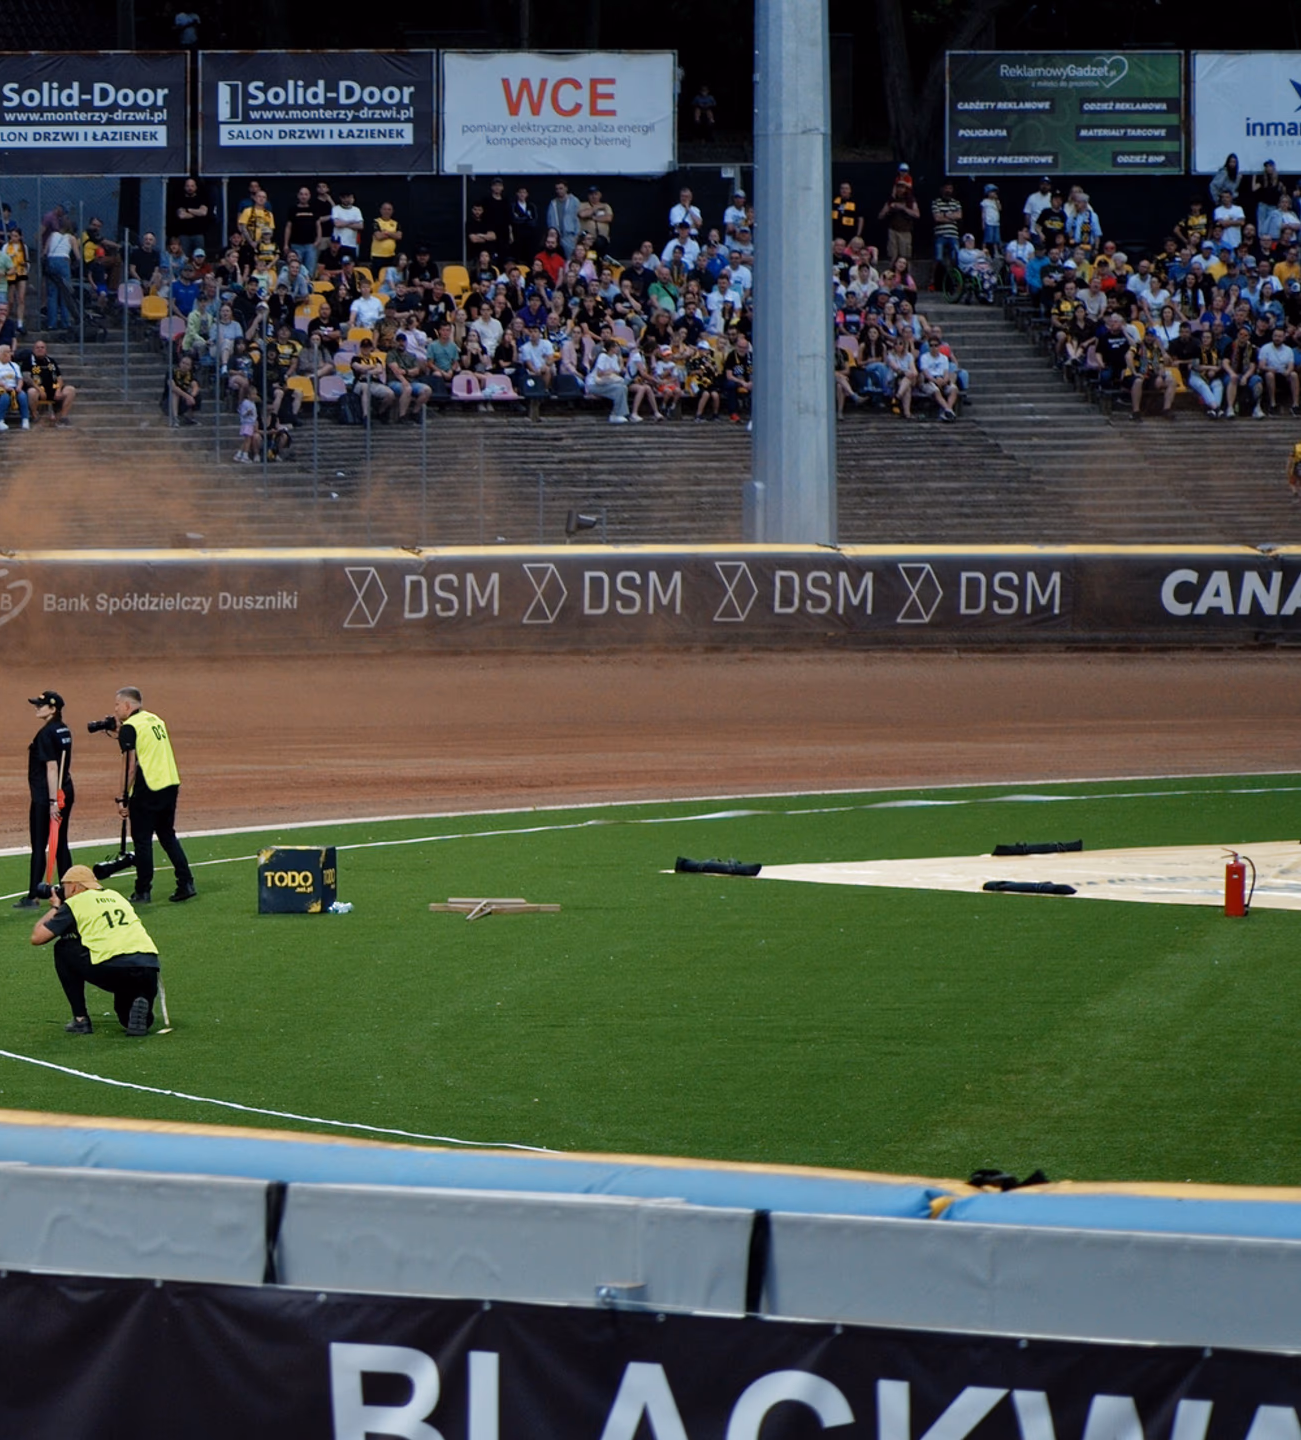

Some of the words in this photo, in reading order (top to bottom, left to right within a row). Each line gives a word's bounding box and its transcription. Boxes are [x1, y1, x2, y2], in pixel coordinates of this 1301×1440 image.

[2, 81, 169, 107] Solid-Door
[247, 79, 415, 106] Solid-Door
[501, 77, 617, 117] WCE
[3, 109, 168, 123] www.monterzy-drzwi.pl
[249, 106, 414, 121] www.monterzy-drzwi.pl
[33, 131, 79, 142] DRZWI
[92, 131, 159, 142] ŁAZIENEK
[227, 129, 273, 140] SALON
[278, 129, 325, 140] DRZWI
[337, 128, 405, 139] ŁAZIENEK
[461, 123, 508, 135] pomiary
[1246, 117, 1301, 137] inma
[486, 135, 557, 148] kompensacja
[560, 137, 591, 147] mocy
[594, 135, 631, 147] biernej
[43, 593, 90, 612] Bank
[95, 591, 213, 615] Spółdzielczy
[218, 590, 299, 611] Duszniki
[403, 572, 500, 619] DSM
[583, 571, 682, 615] DSM
[773, 571, 874, 615] DSM
[959, 571, 1061, 615] DSM
[263, 870, 313, 887] TODO
[101, 908, 129, 928] 12
